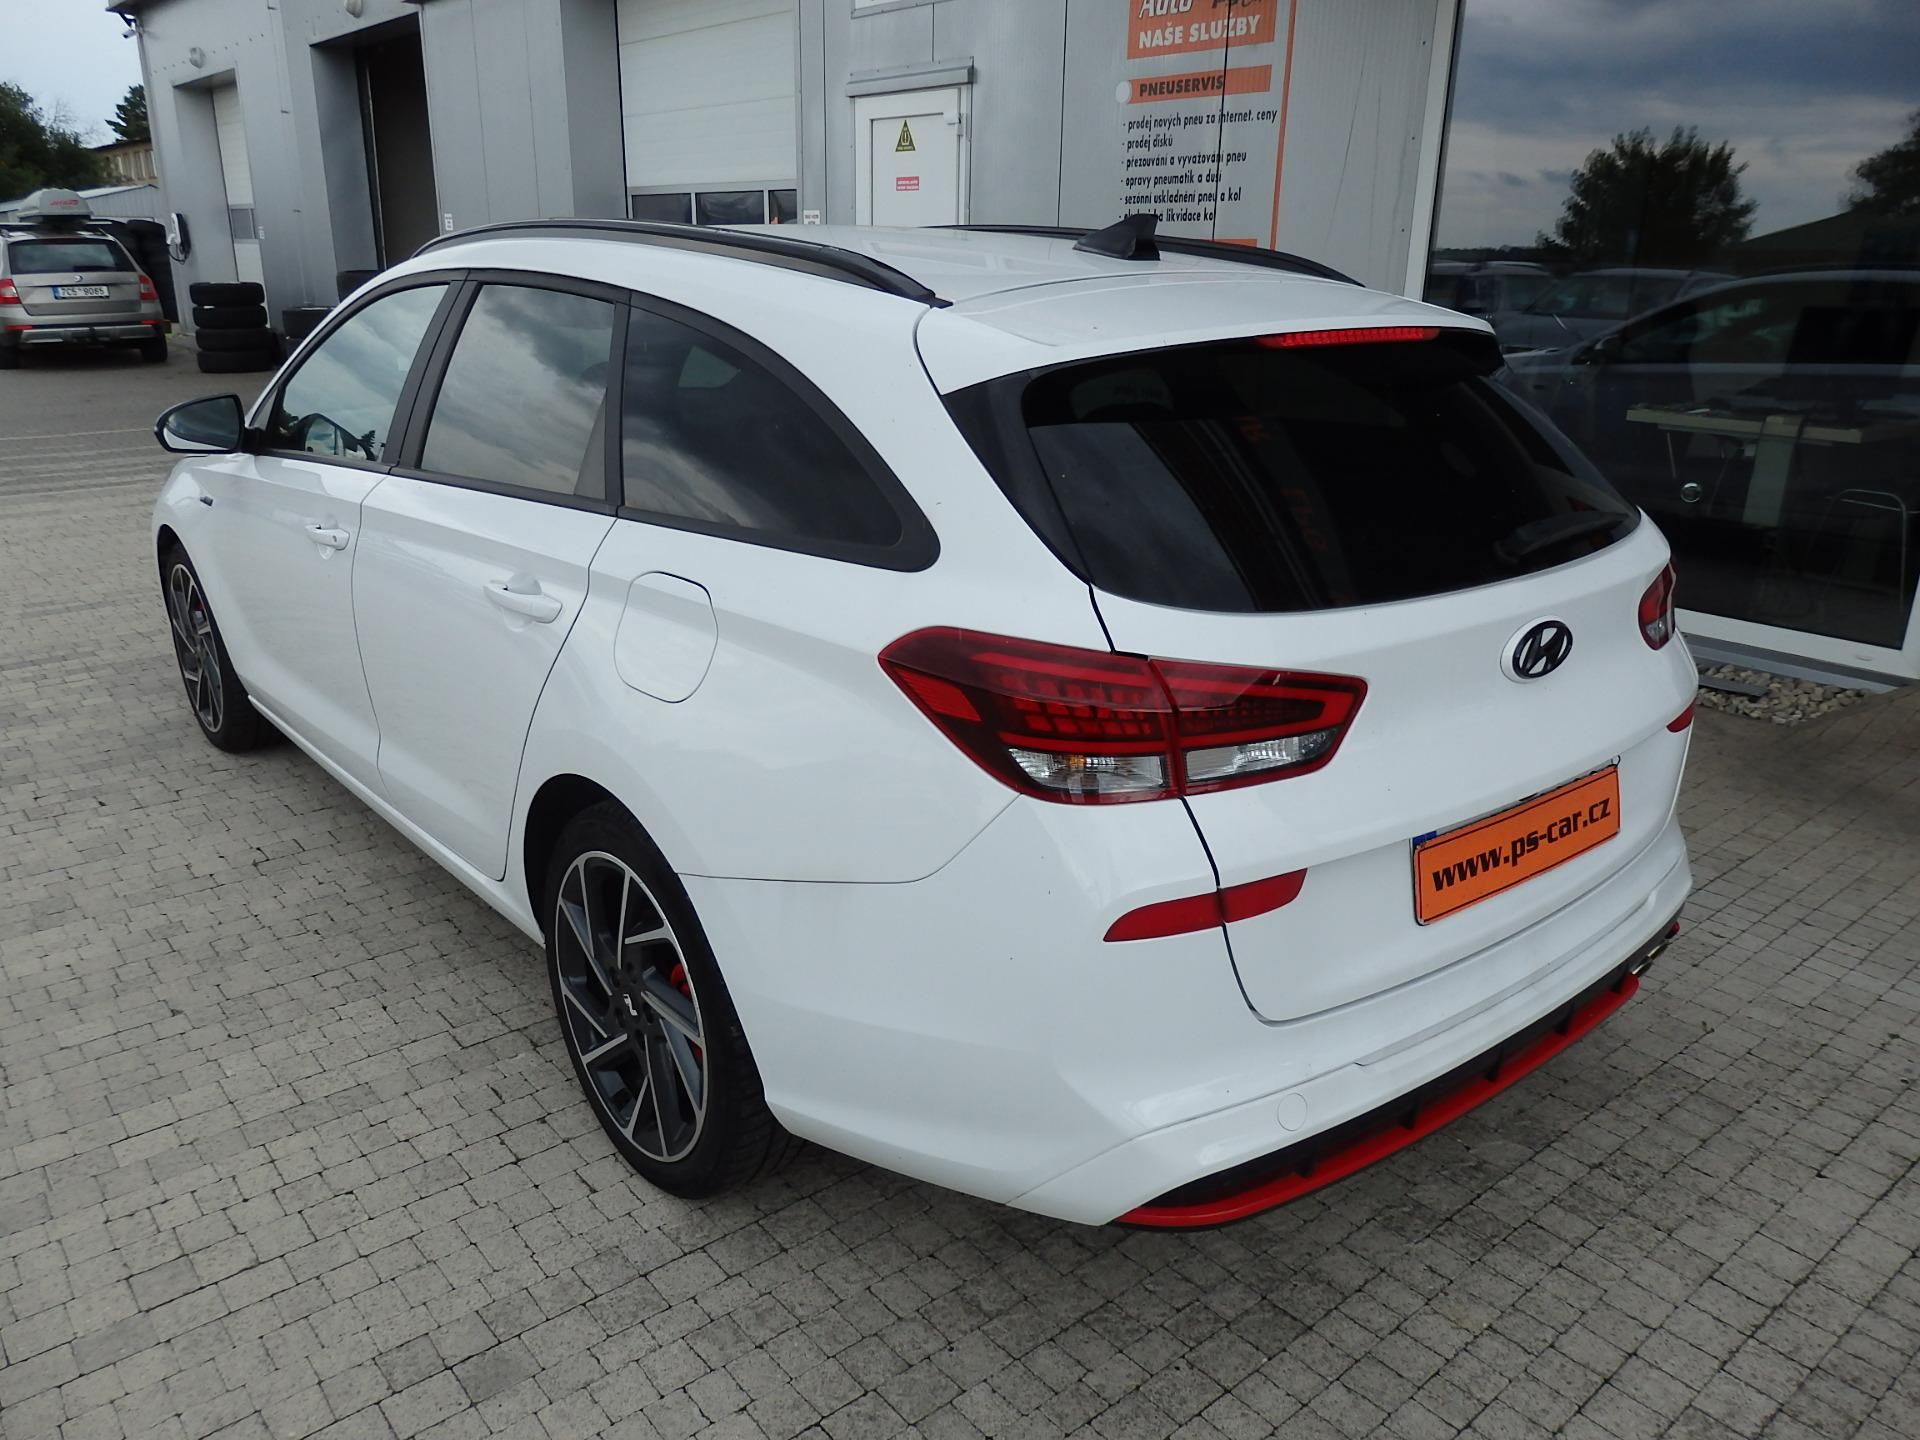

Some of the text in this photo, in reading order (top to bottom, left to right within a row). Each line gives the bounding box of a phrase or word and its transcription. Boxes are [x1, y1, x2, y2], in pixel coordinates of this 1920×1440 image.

[1139, 13, 1261, 48] NAŠE SLUŽBY
[1139, 75, 1224, 97] PNEUSERVIS
[1128, 114, 1152, 133] prodej
[1184, 114, 1203, 130] pneu
[1257, 110, 1278, 123] ceny
[1127, 134, 1151, 153] prodej
[1226, 151, 1247, 166] pneu
[1125, 175, 1152, 189] opravy
[1153, 169, 1195, 188] pneumatik
[1228, 187, 1242, 202] kol
[1166, 206, 1201, 222] likvidace
[1432, 798, 1612, 892] www.ps-car.cz
